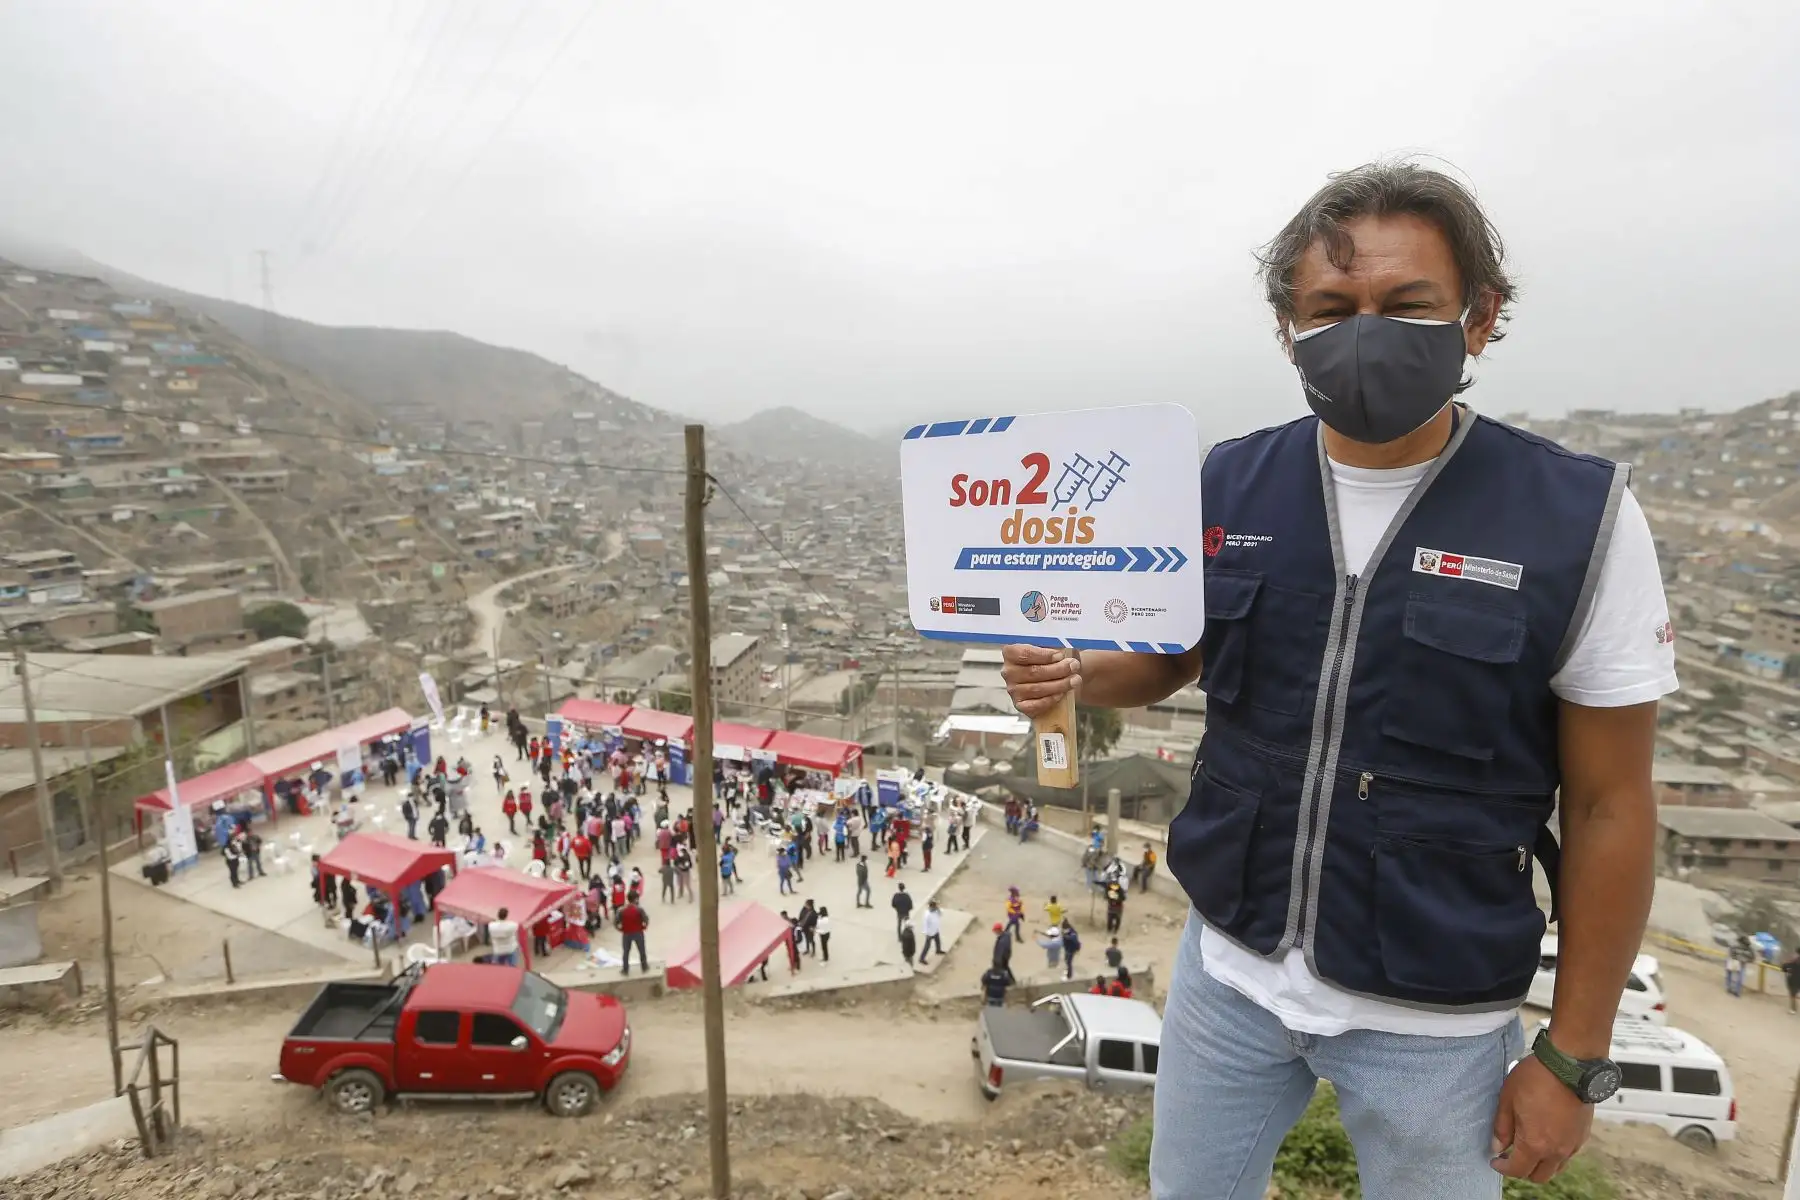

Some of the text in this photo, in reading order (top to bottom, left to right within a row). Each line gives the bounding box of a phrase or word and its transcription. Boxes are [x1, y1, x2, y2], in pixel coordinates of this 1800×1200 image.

[949, 452, 1051, 507] Son 2
[1000, 506, 1096, 545] dosis
[1226, 534, 1273, 542] BICENTENARIO
[970, 550, 1116, 569] para estar protegido
[1441, 560, 1462, 570] PERÚ
[1464, 563, 1494, 575] Ministerio
[1502, 570, 1518, 580] Salud
